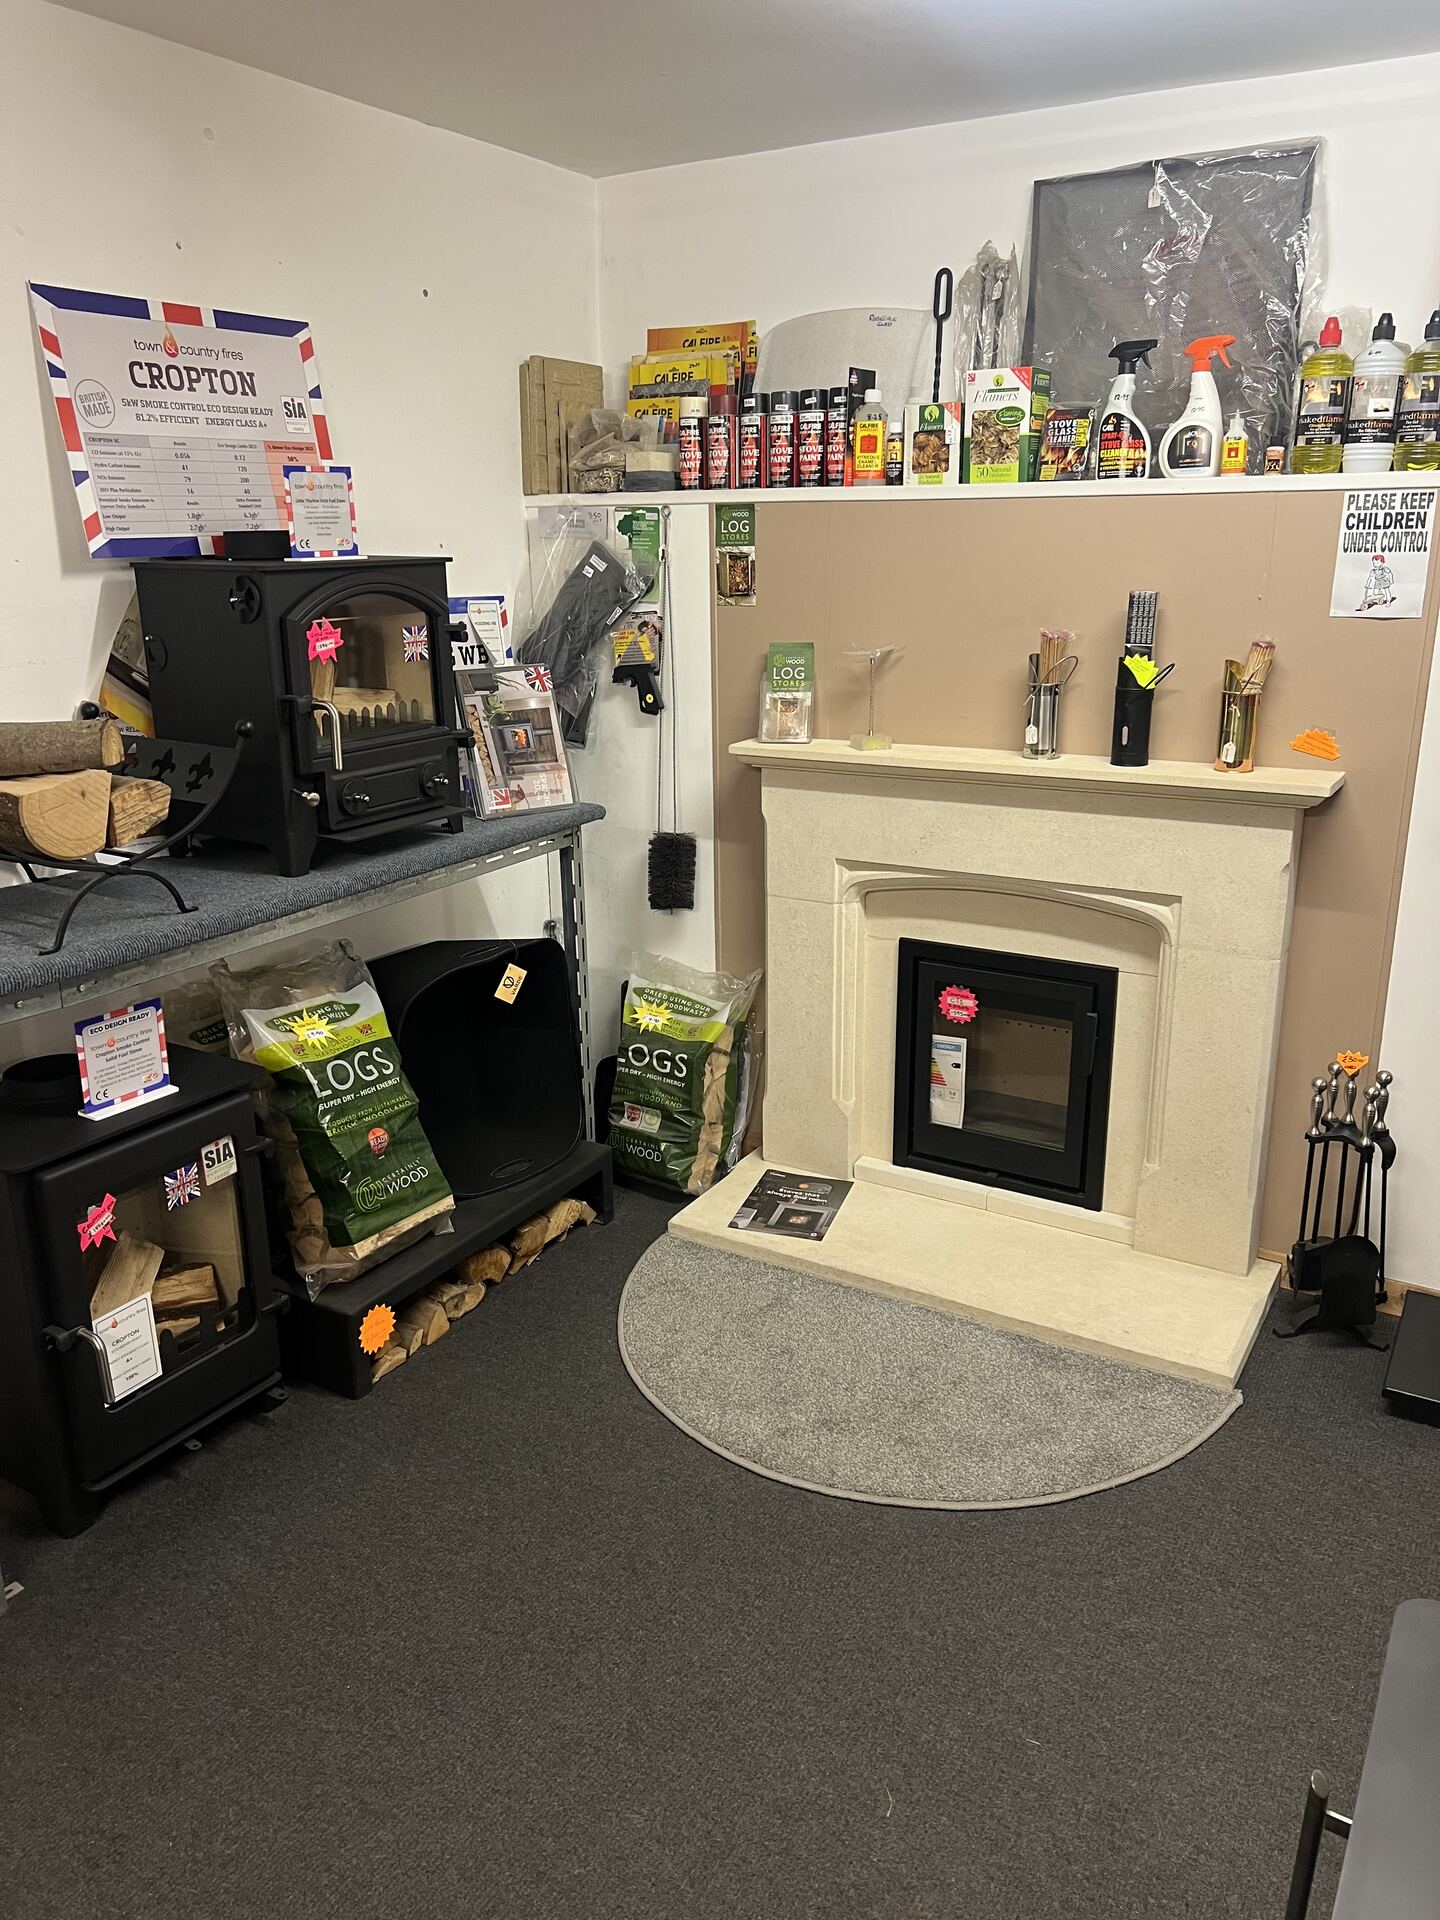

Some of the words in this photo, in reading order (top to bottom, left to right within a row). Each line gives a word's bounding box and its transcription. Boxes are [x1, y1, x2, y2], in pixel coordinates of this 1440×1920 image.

[134, 339, 162, 352] town
[180, 345, 219, 360] country
[221, 347, 243, 360] fires
[128, 361, 257, 397] CROPTON
[78, 391, 107, 404] BRITISH
[974, 389, 1020, 404] Flamers
[83, 401, 112, 418] MADE
[140, 399, 170, 410] SMOKE
[170, 401, 206, 412] CONTROL
[207, 402, 221, 413] ECO
[222, 403, 249, 414] DESIGN
[249, 405, 274, 417] READY
[159, 414, 200, 425] EFFICIENT
[205, 417, 235, 428] ENERGY
[235, 418, 258, 428] CLASS
[258, 419, 268, 429] A+
[1048, 419, 1077, 429] STOVE
[1047, 435, 1076, 443] CLEANER
[1048, 427, 1077, 436] GLASS
[710, 449, 729, 457] TOVE
[799, 445, 824, 453] STOVE
[1101, 440, 1121, 449] STOVE
[977, 467, 989, 478] 50
[1347, 493, 1397, 511] PLEASE
[1400, 492, 1435, 510] KEEP
[721, 520, 750, 533] LOG
[1345, 511, 1428, 531] CHILDREN
[721, 533, 750, 541] STORES
[1343, 531, 1379, 553] UNDER
[1380, 531, 1428, 553] CONTROL
[458, 645, 489, 665] WB
[773, 666, 805, 680] LOG
[642, 994, 660, 1005] OWN
[644, 987, 668, 1000] DRIED
[669, 995, 692, 1007] USING
[694, 1003, 711, 1012] OUR
[90, 1026, 104, 1035] ECO
[104, 1018, 127, 1030] DESIGN
[128, 1011, 150, 1023] READY
[90, 1043, 107, 1052] town
[116, 1032, 139, 1044] country
[95, 1049, 115, 1059] Cropton
[116, 1043, 132, 1052] Smoke
[133, 1037, 151, 1046] Control
[305, 1046, 394, 1098] LOGS
[629, 1068, 643, 1077] DRY
[646, 1072, 662, 1082] HIGH
[663, 1077, 686, 1088] ENERGY
[96, 1088, 109, 1100] CE
[318, 1096, 342, 1111] SUPER
[342, 1092, 355, 1103] DRY
[359, 1087, 376, 1098] HIGH
[376, 1076, 401, 1091] ENERGY
[640, 1093, 682, 1109] WOODLAND
[358, 1107, 373, 1117] FROM
[374, 1094, 409, 1112] SUSTAINABLE
[363, 1100, 411, 1122] WOODLAND
[626, 1136, 659, 1150] CERTAINL
[626, 1143, 662, 1162] WOOD
[382, 1157, 421, 1183] CERTAINLY
[387, 1165, 429, 1195] WOOD
[766, 1190, 792, 1199] always
[111, 1328, 140, 1347] CROPTON
